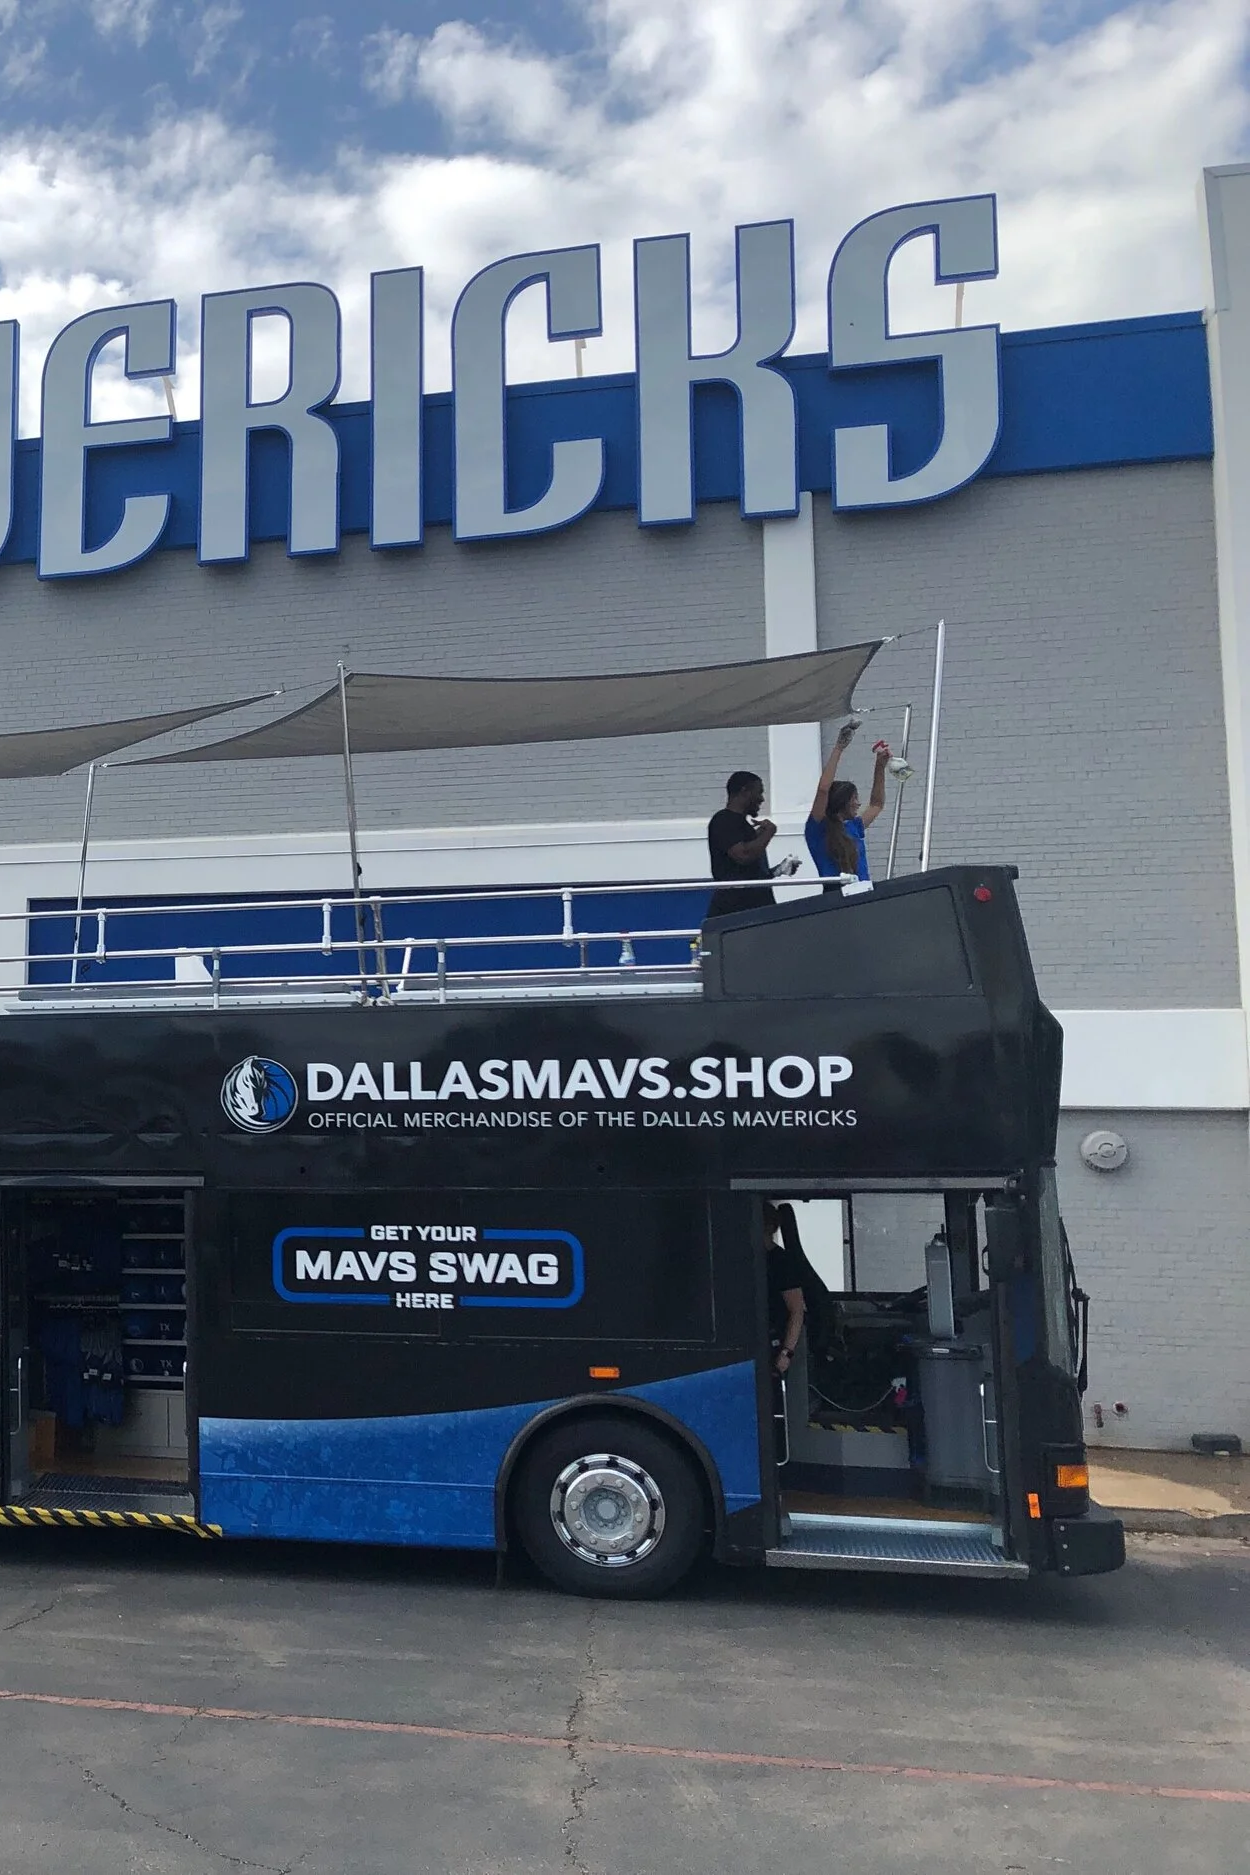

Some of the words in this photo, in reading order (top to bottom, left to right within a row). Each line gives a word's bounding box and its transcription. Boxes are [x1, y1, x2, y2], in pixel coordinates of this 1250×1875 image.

[306, 1054, 854, 1101] DALLASMAVS.SHOP
[307, 1111, 399, 1129] OFFICIAL
[403, 1110, 553, 1129] MERCHANDISE
[558, 1110, 590, 1128] OF
[594, 1110, 637, 1128] THE
[642, 1109, 726, 1128] DALLAS
[732, 1108, 858, 1128] MAVERICKS
[370, 1224, 412, 1242] GET
[415, 1225, 478, 1243] YOUR
[295, 1250, 418, 1283] MAVS
[428, 1251, 559, 1286] SWAG
[395, 1292, 455, 1310] HERE
